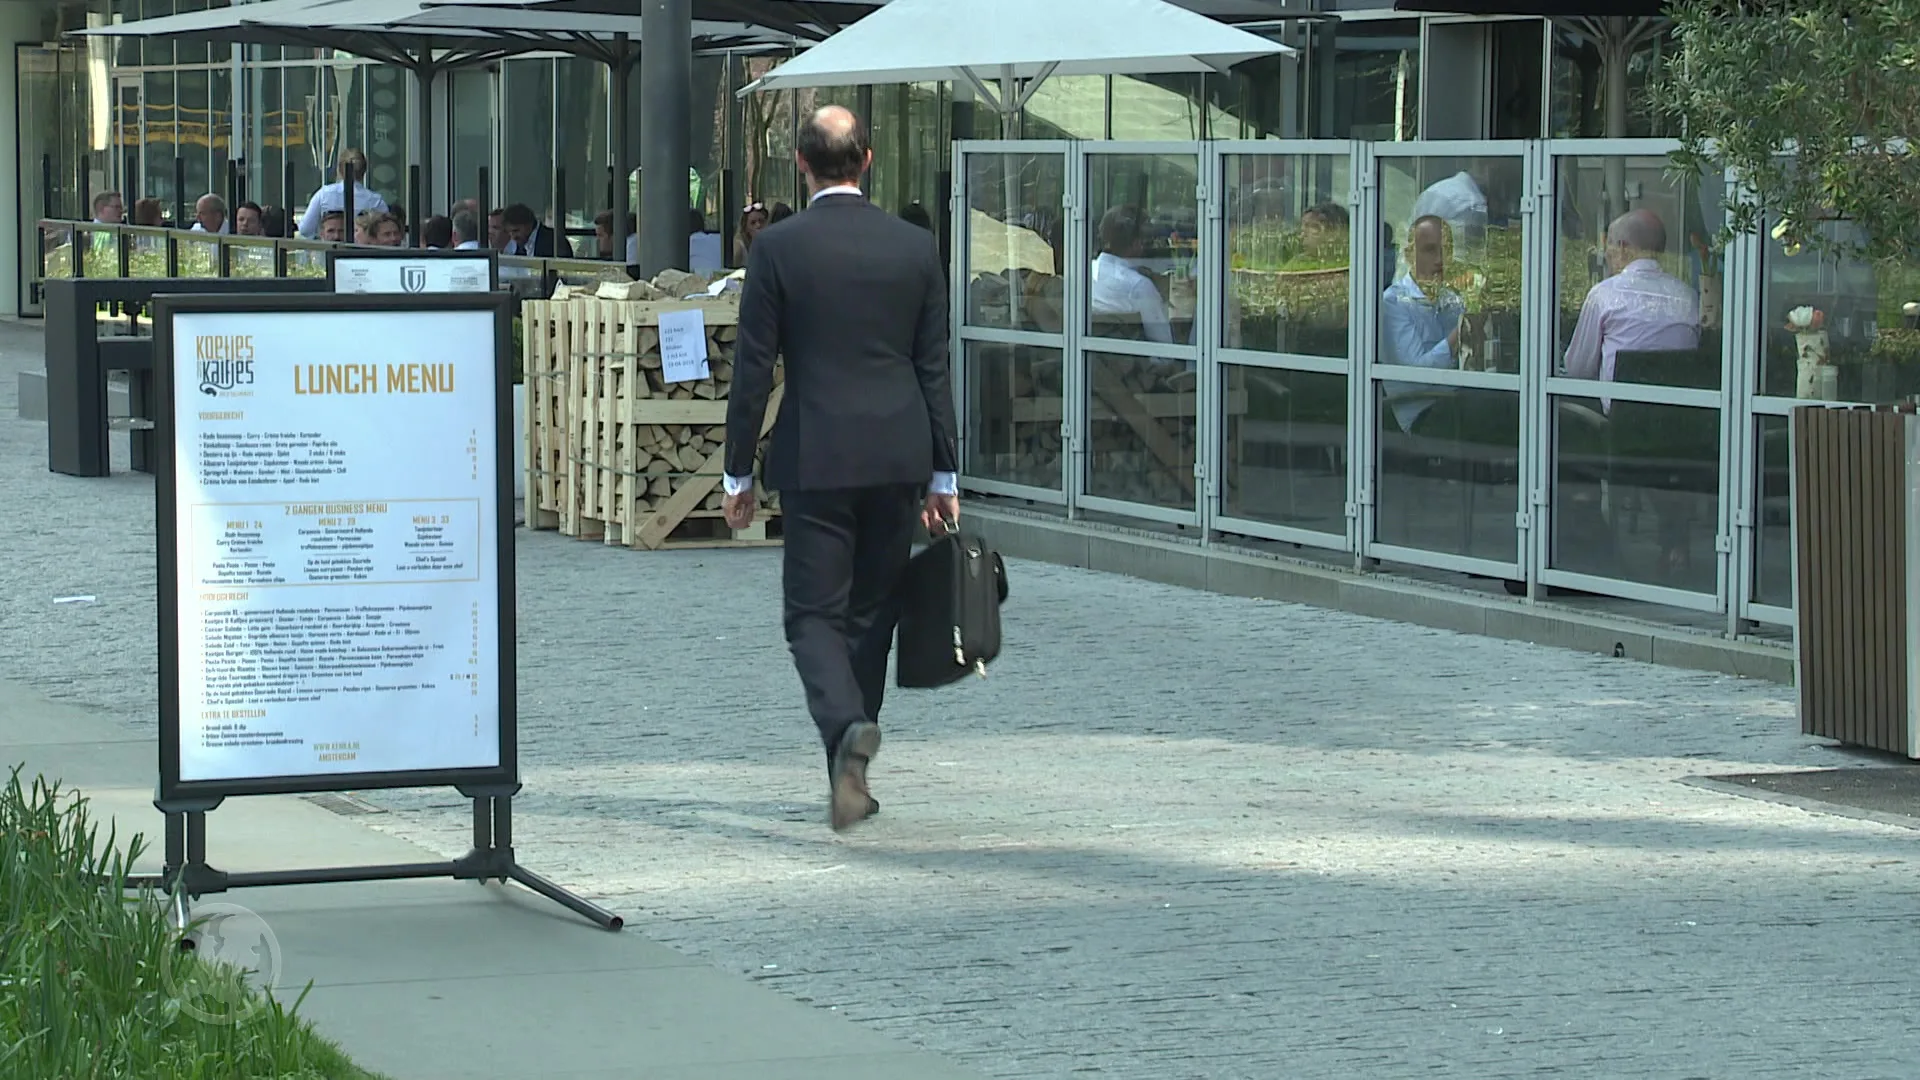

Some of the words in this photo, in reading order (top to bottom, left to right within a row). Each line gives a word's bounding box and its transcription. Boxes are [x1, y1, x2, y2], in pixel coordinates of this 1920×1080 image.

[294, 363, 378, 394] LUNCH
[386, 362, 455, 393] MENU
[285, 506, 290, 515] 2
[292, 505, 323, 515] GANGEN
[326, 504, 364, 514] BUSINESS
[366, 504, 388, 513] MENU
[319, 518, 336, 526] MENU
[413, 516, 430, 524] MENU
[319, 752, 356, 762] AMSTERDAM
